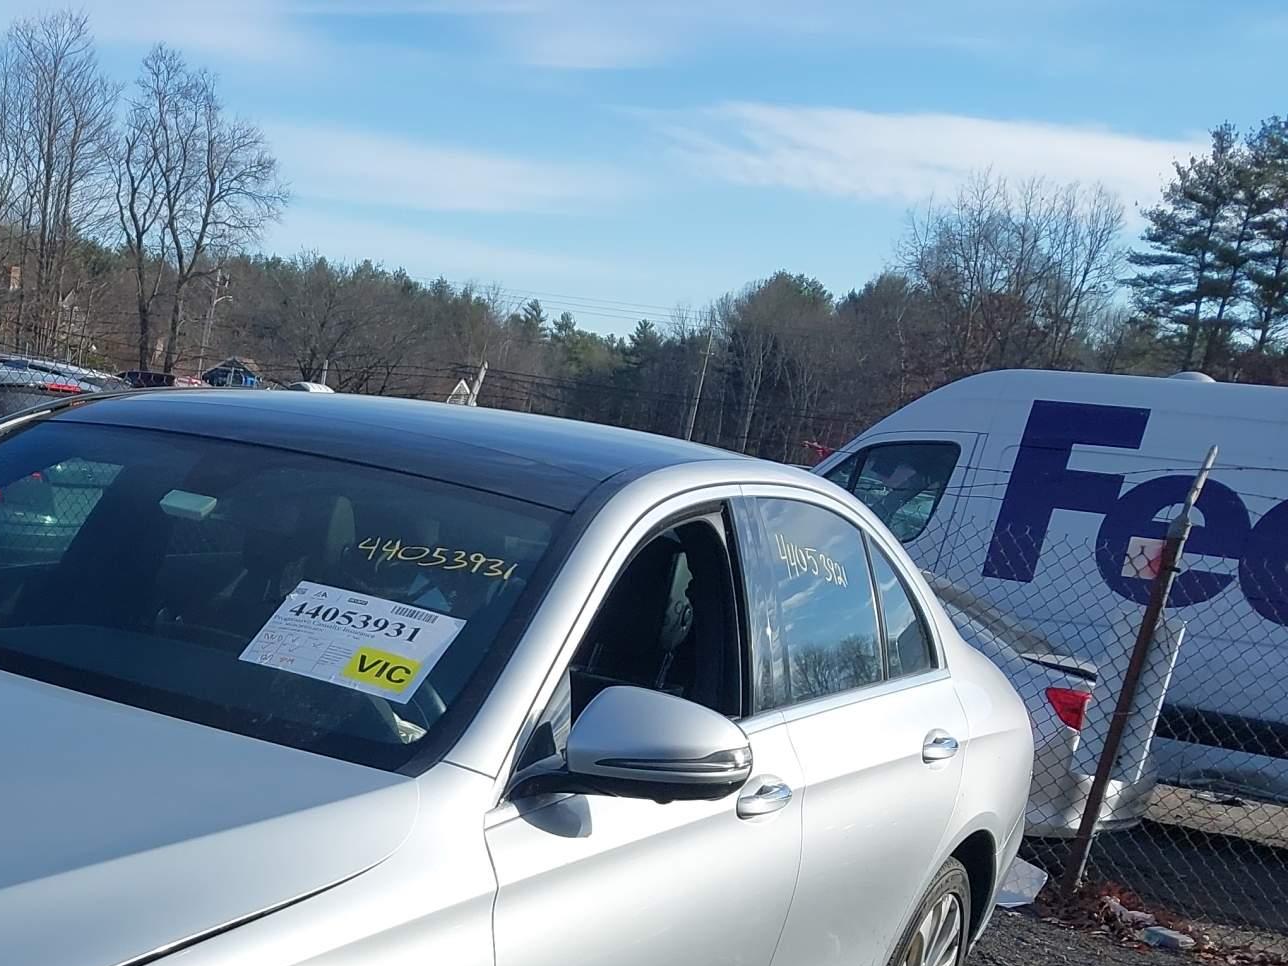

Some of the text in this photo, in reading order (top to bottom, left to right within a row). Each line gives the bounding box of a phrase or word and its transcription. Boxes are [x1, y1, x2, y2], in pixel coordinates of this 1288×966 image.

[358, 537, 518, 580] 44053931
[289, 601, 421, 643] 44053931
[357, 654, 411, 684] VIC
